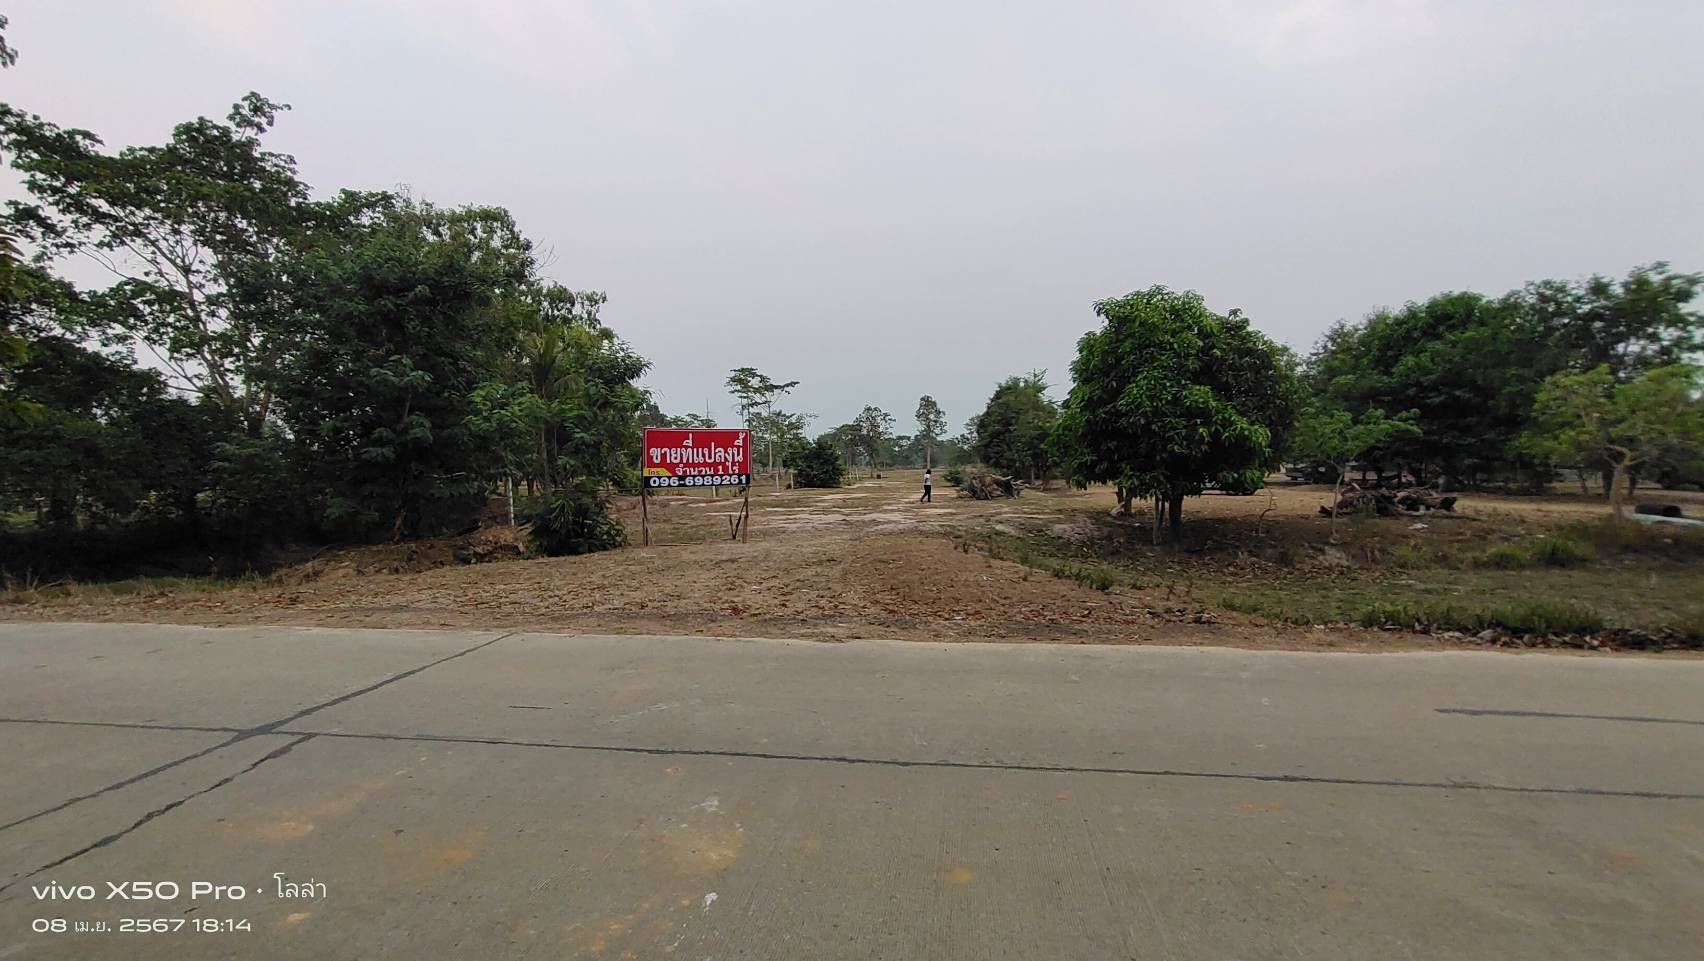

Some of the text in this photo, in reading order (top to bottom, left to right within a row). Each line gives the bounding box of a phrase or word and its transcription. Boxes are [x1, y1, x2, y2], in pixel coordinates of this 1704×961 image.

[649, 432, 745, 463] ขายที่แปลงนี้
[675, 461, 739, 475] จำนวน 1 ไร่
[650, 475, 747, 487] 096-6989261
